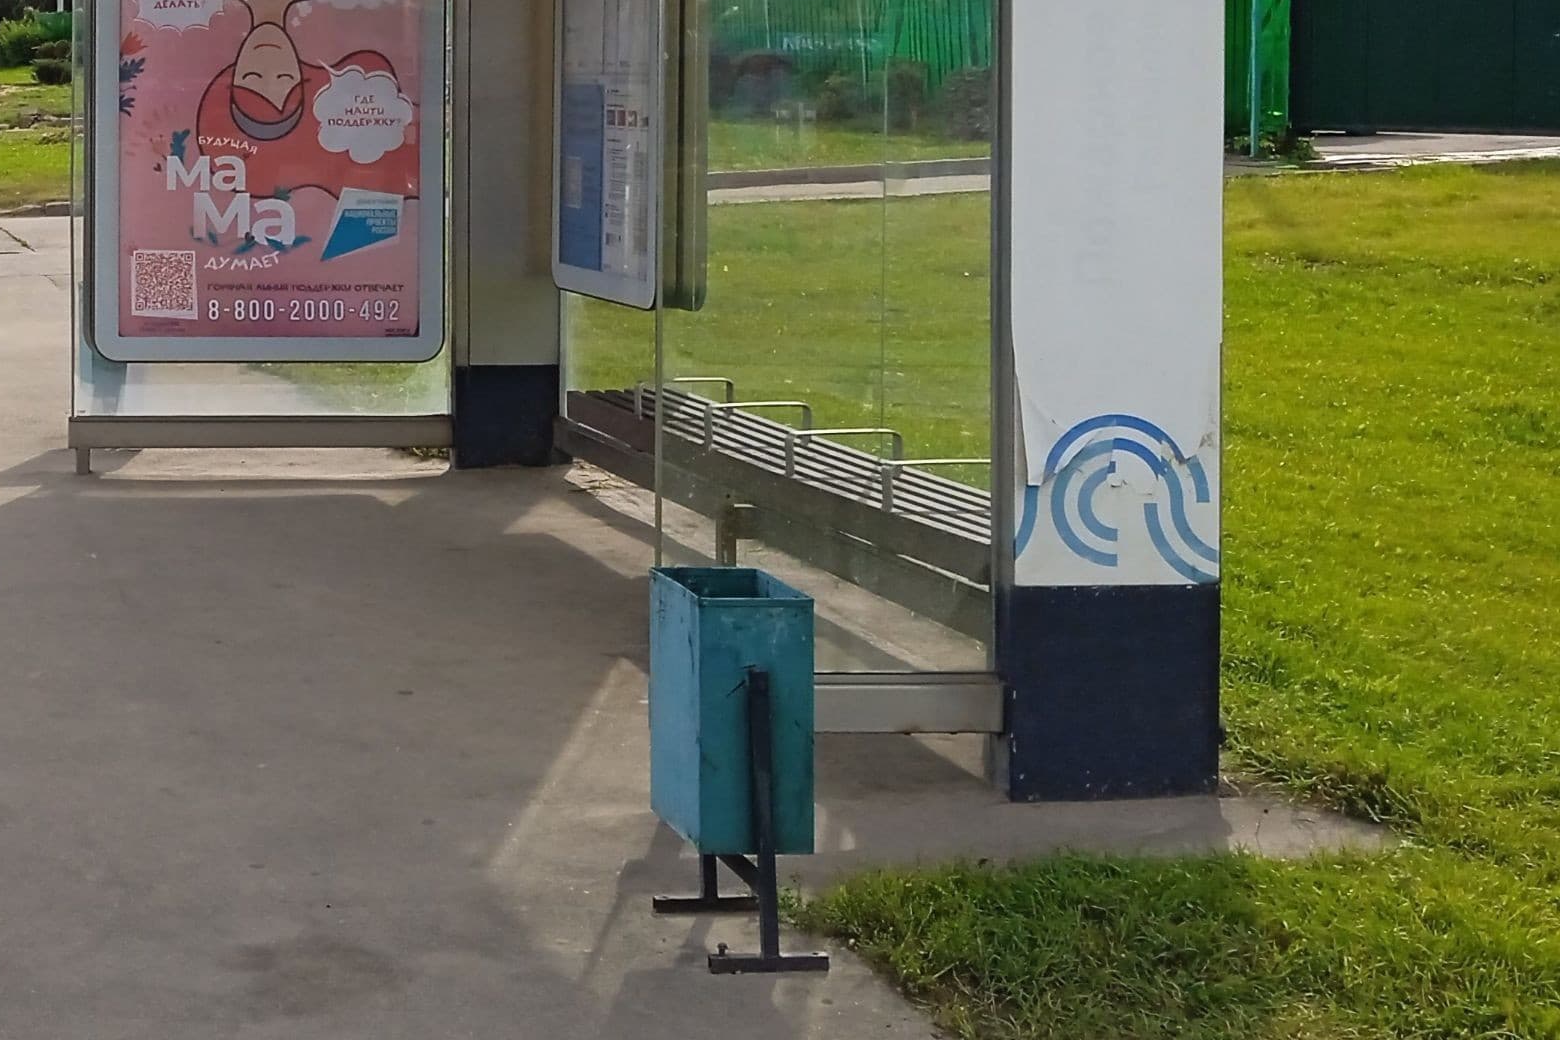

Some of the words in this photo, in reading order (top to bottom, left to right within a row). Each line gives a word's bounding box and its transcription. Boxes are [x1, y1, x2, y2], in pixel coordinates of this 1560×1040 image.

[354, 94, 375, 104] ГДЕ
[198, 135, 258, 155] БУДУЩАЯ
[204, 250, 281, 271] ДУМАЕТ
[208, 299, 400, 321] 8-800-2000-492
